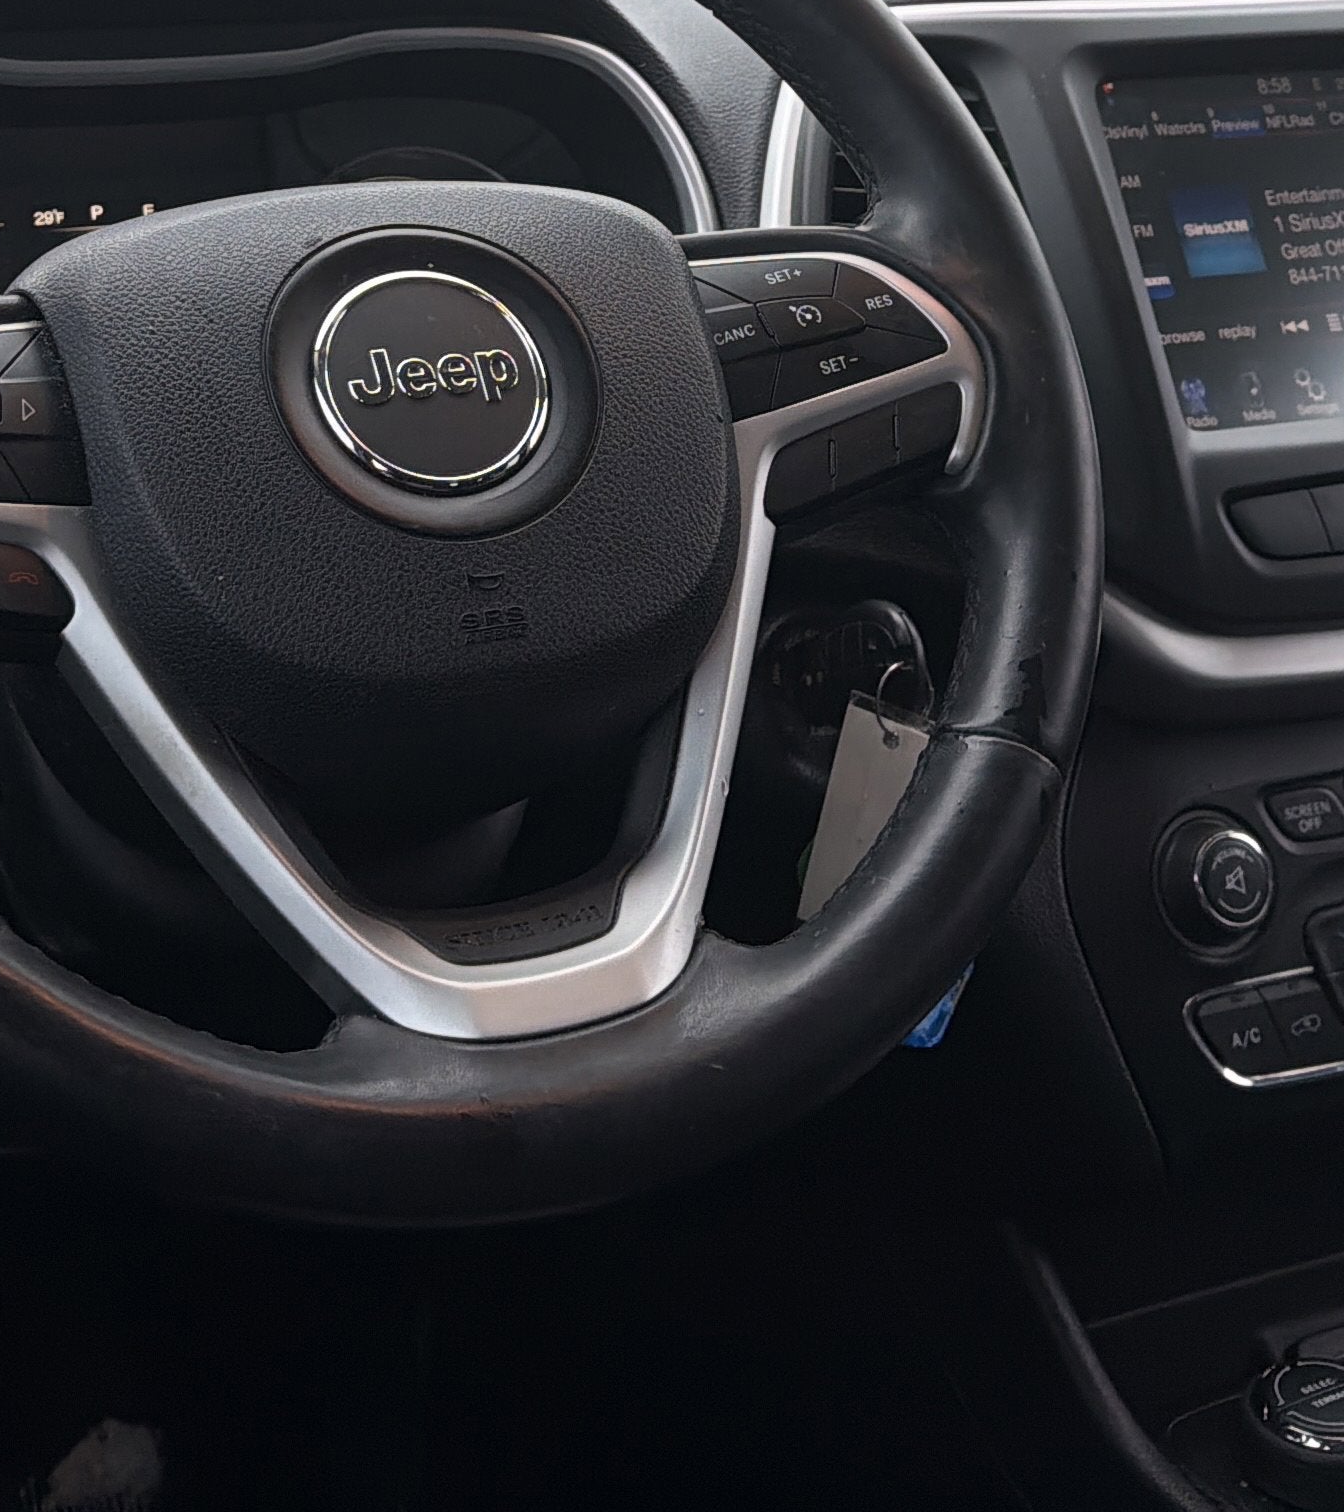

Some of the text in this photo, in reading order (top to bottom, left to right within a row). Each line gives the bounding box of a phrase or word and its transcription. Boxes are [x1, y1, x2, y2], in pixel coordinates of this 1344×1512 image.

[1212, 117, 1260, 133] Preview
[1120, 174, 1142, 189] AM
[90, 204, 104, 221] P
[1133, 223, 1155, 238] FM
[1183, 219, 1249, 237] SiriusXM
[1273, 215, 1285, 233] 1
[1281, 242, 1323, 260] Great
[764, 268, 803, 285] SET+
[864, 294, 894, 311] RES
[713, 324, 756, 346] CANC
[1218, 322, 1257, 341] replay
[346, 348, 520, 406] Jeep
[1186, 415, 1218, 428] Radio
[1242, 408, 1278, 422] Media
[1284, 800, 1332, 821] SCREEN
[1297, 816, 1323, 834] OFF
[1232, 1027, 1262, 1048] A/C
